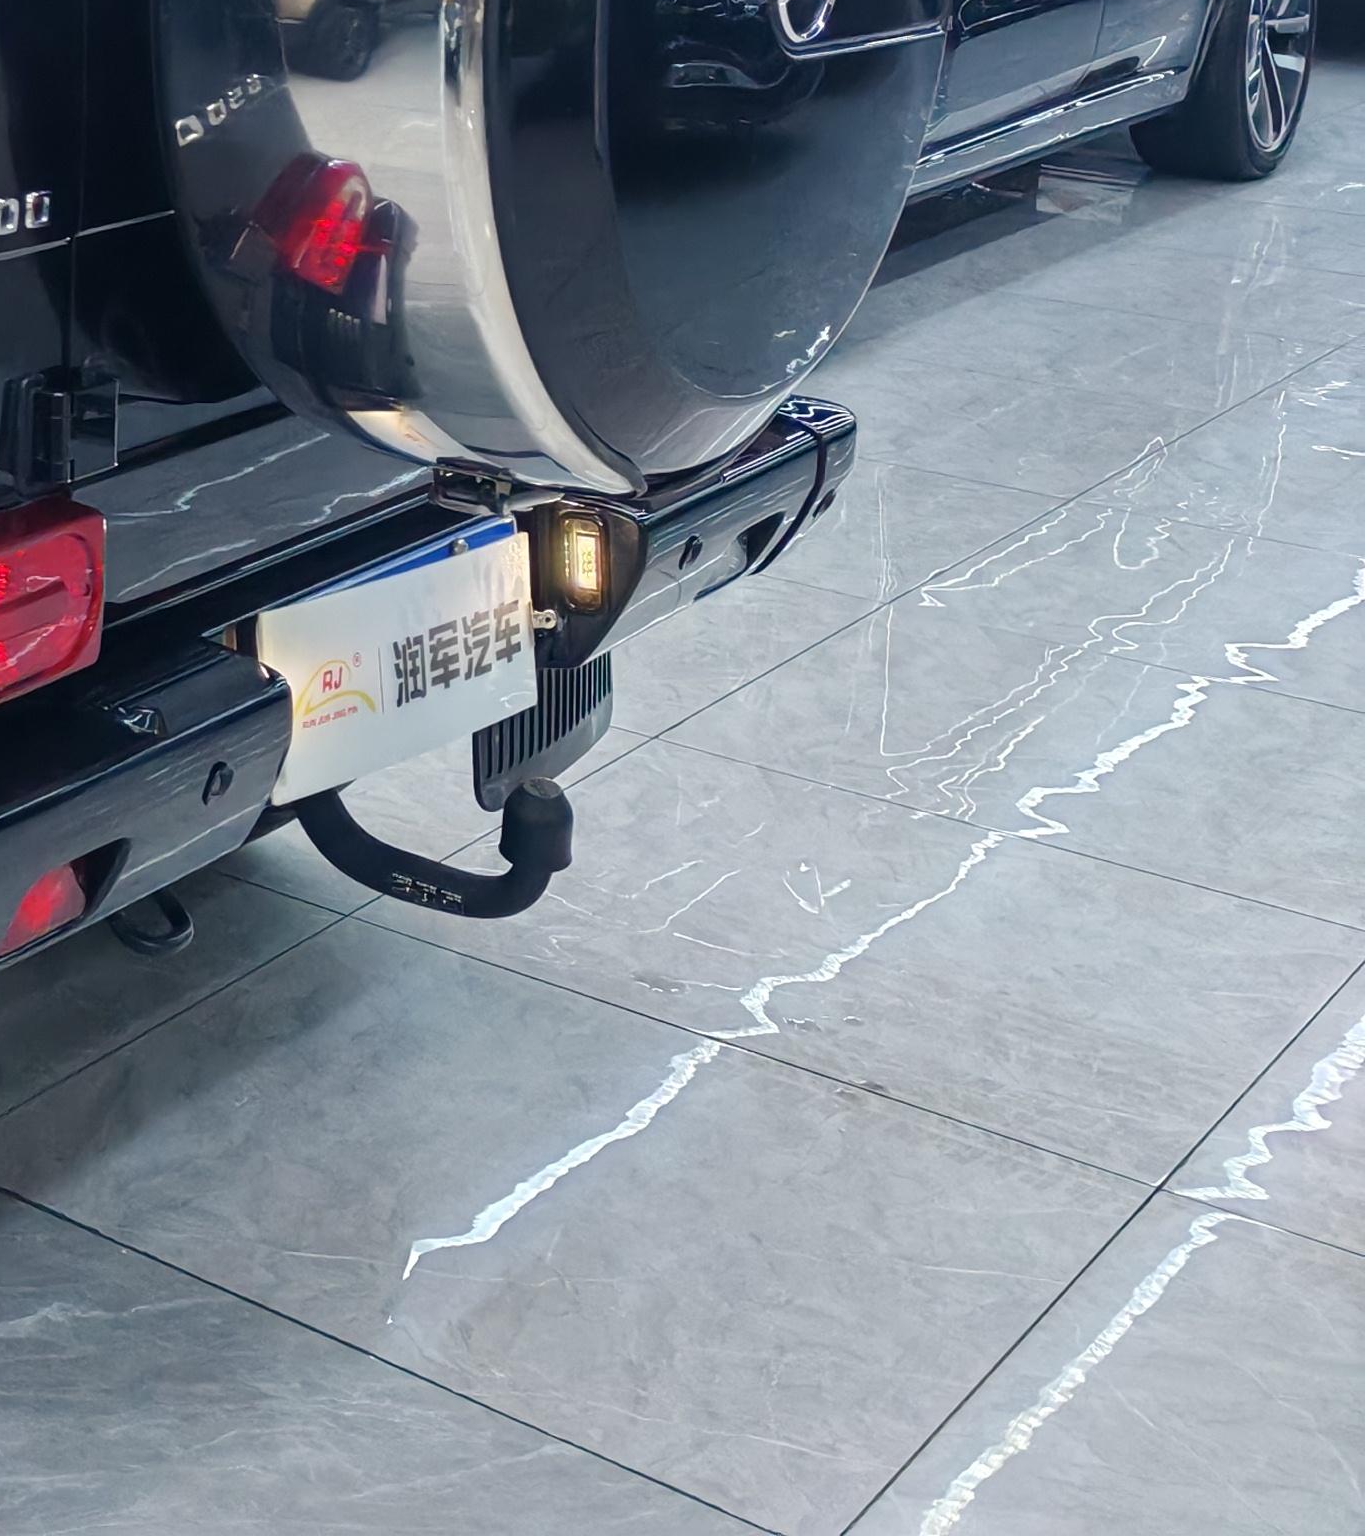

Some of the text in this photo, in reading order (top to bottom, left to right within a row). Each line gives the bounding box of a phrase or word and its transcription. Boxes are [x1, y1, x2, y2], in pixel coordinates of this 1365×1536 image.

[321, 665, 343, 693] RJ
[392, 599, 522, 708] 润军汽车
